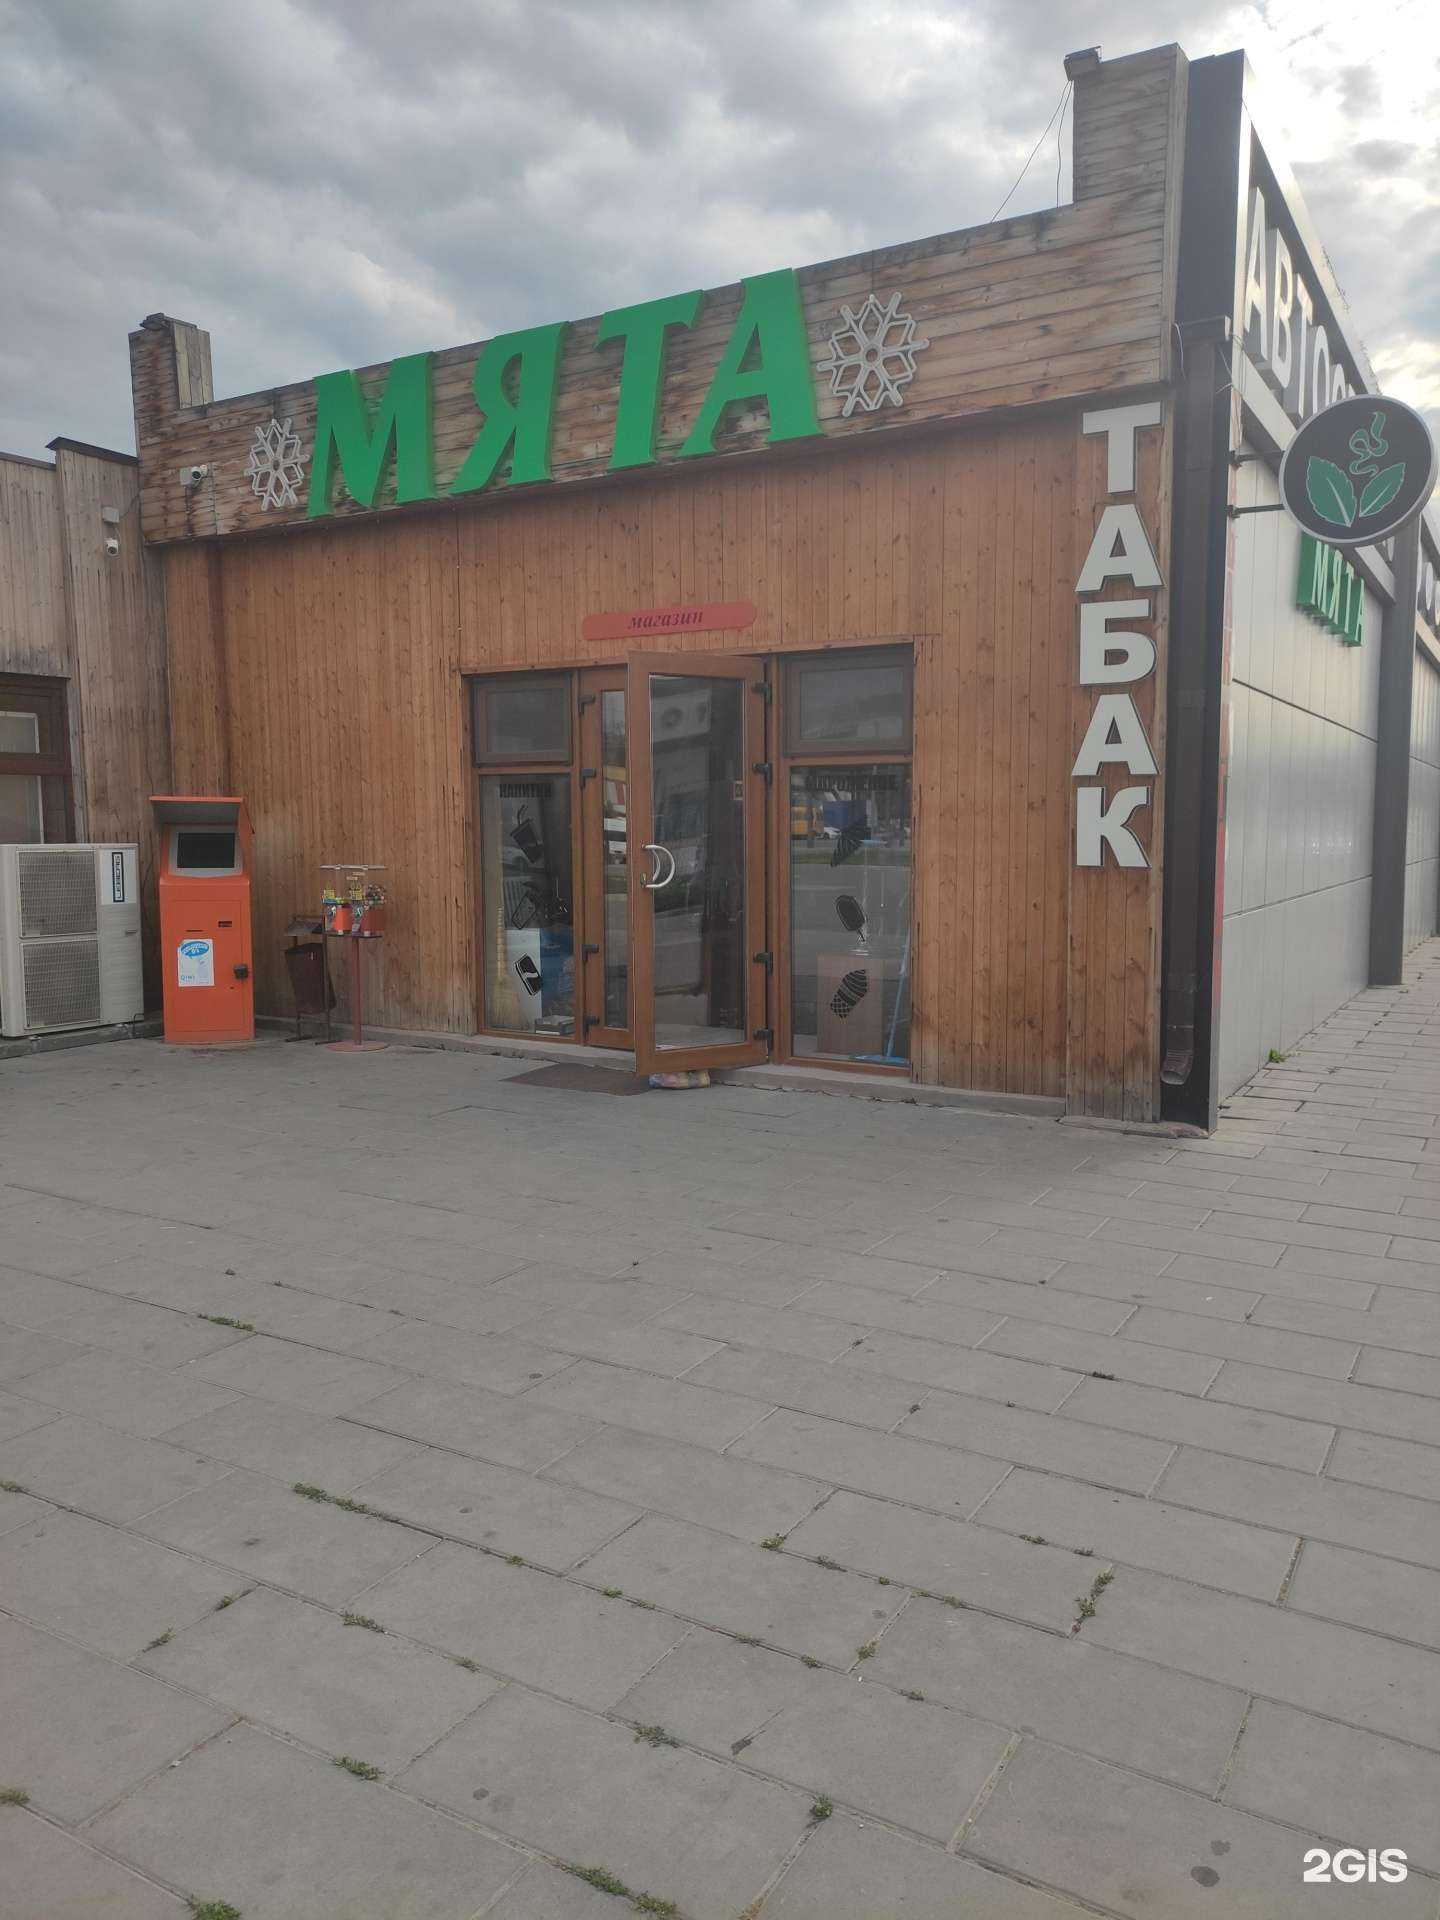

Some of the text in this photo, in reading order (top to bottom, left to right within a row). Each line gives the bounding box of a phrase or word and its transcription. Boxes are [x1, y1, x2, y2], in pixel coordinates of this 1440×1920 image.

[307, 268, 824, 519] МЯТА
[628, 611, 703, 629] магазин
[1072, 402, 1164, 868] ТАБАК
[1304, 537, 1365, 646] МЯТА
